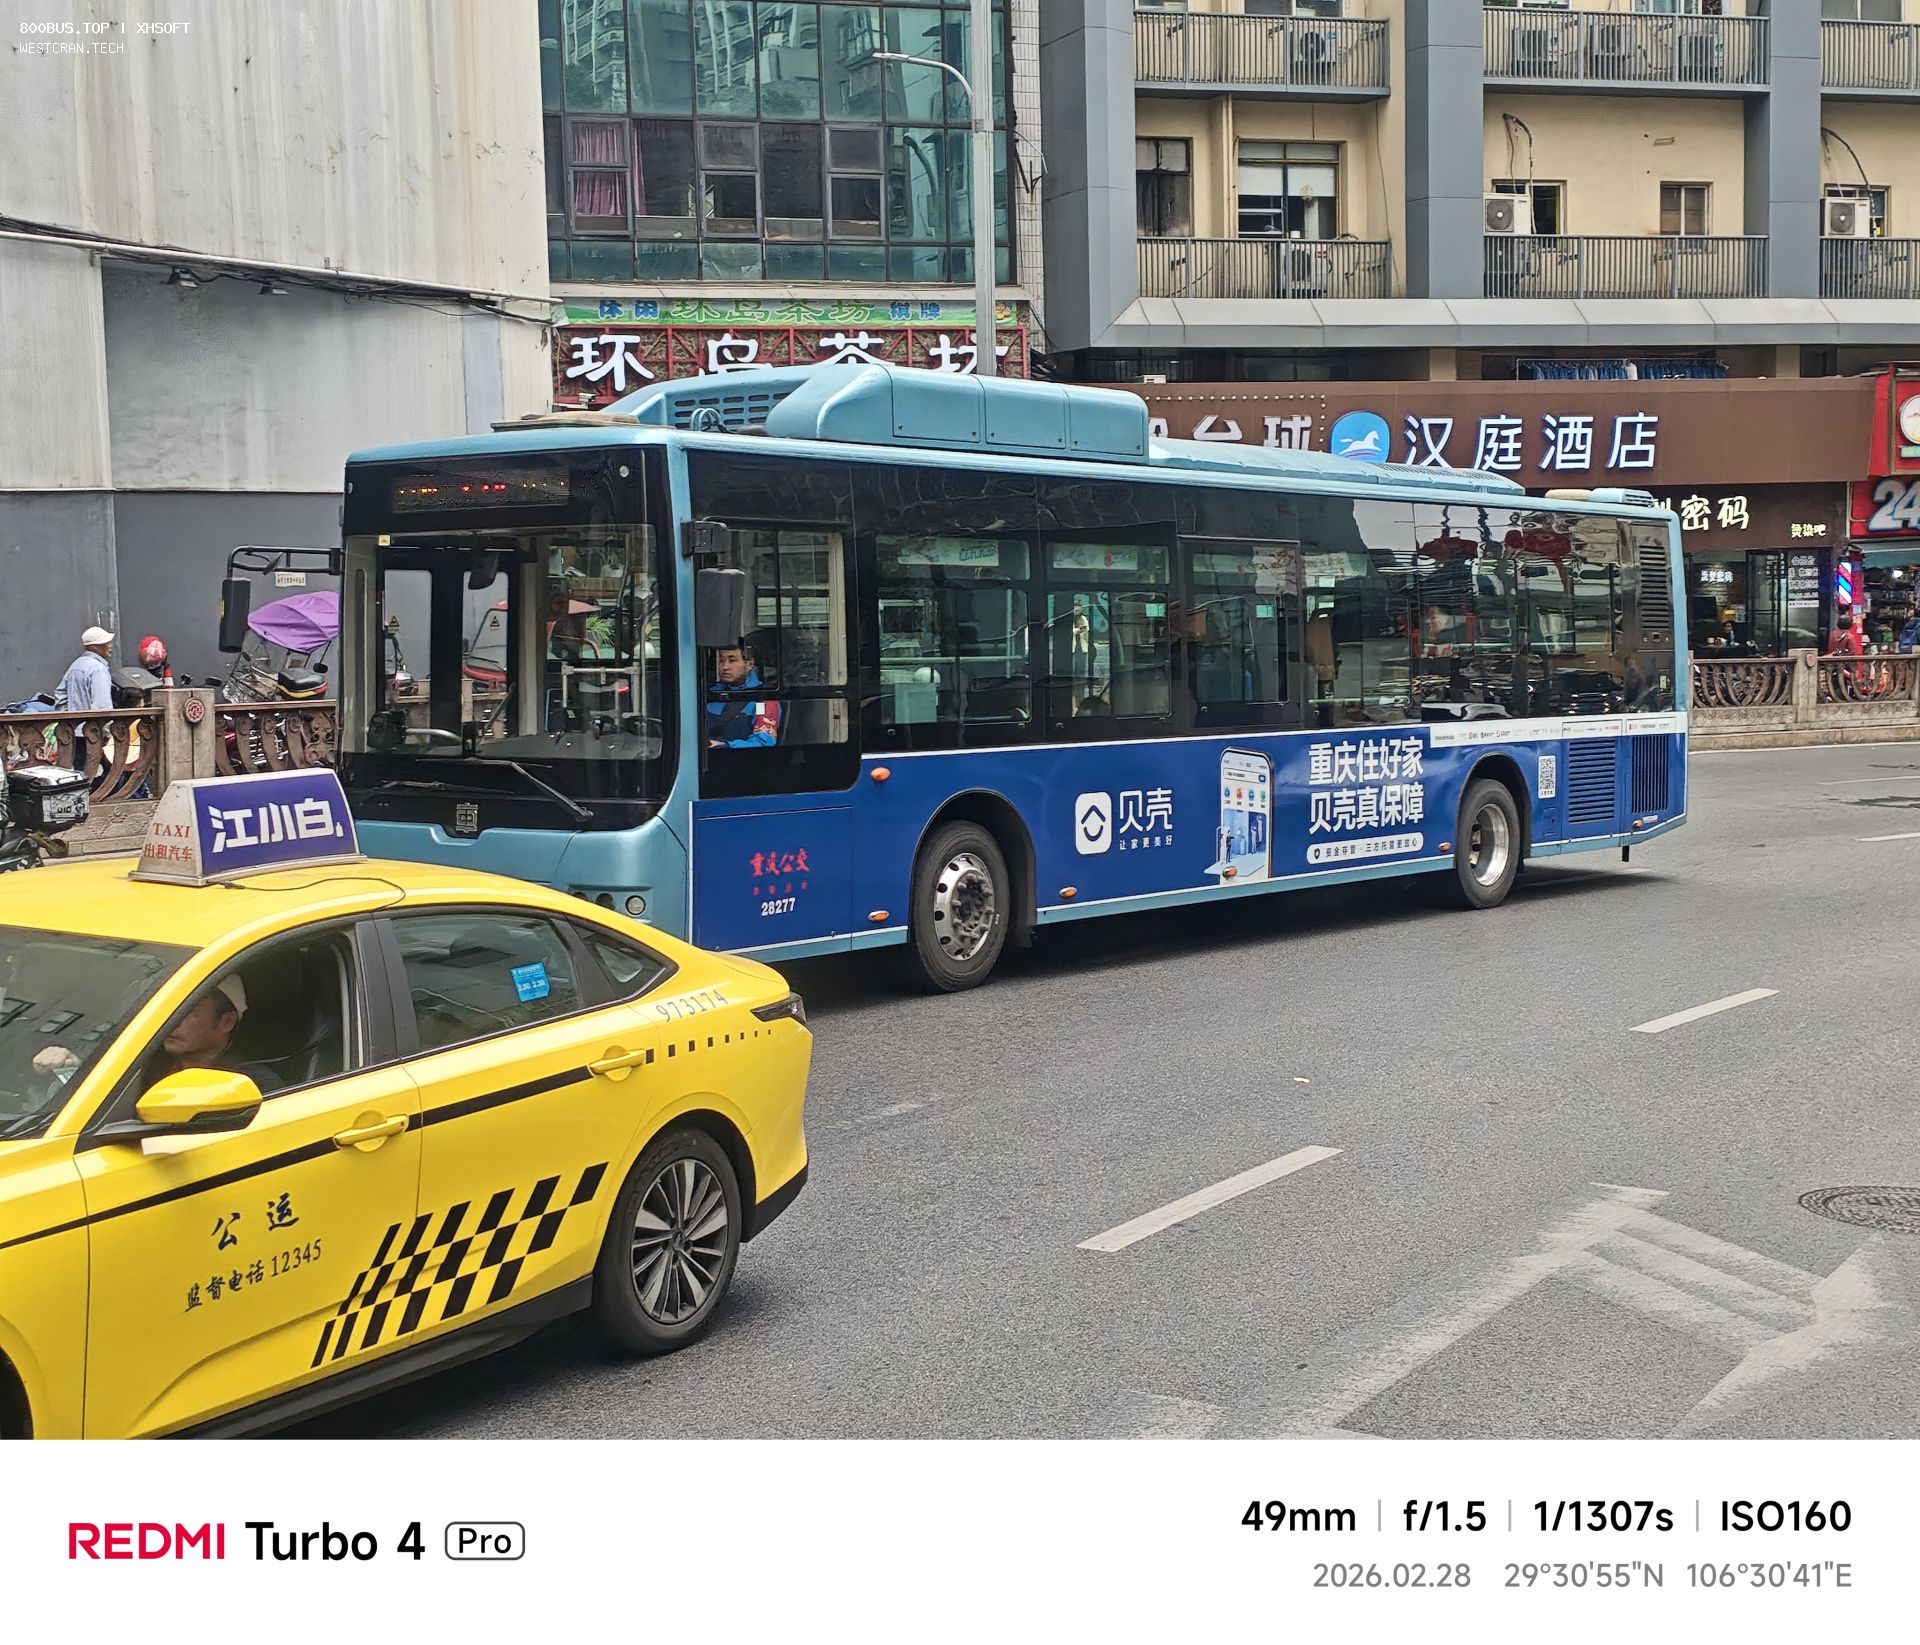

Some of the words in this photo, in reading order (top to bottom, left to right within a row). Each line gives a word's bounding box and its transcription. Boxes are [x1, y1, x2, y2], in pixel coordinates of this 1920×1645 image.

[598, 299, 660, 320] 休闲
[671, 298, 875, 323] 环岛茶坊
[888, 301, 941, 321] 棋牌
[1403, 411, 1660, 471] 汉庭酒店
[1654, 494, 1750, 531] 密码
[1308, 736, 1424, 786] 重庆住好家
[207, 797, 336, 854] 江小白
[1119, 787, 1173, 835] 贝壳
[1308, 781, 1424, 835] 贝壳真保障
[152, 822, 191, 838] TAXI
[1119, 834, 1173, 851] 让家更美好
[142, 842, 193, 862] 出租汽车
[760, 896, 797, 917] 28277
[656, 988, 729, 1022] 973174
[211, 1192, 300, 1251] 公运
[184, 1260, 265, 1313] 监督电话
[271, 1238, 322, 1277] 12345
